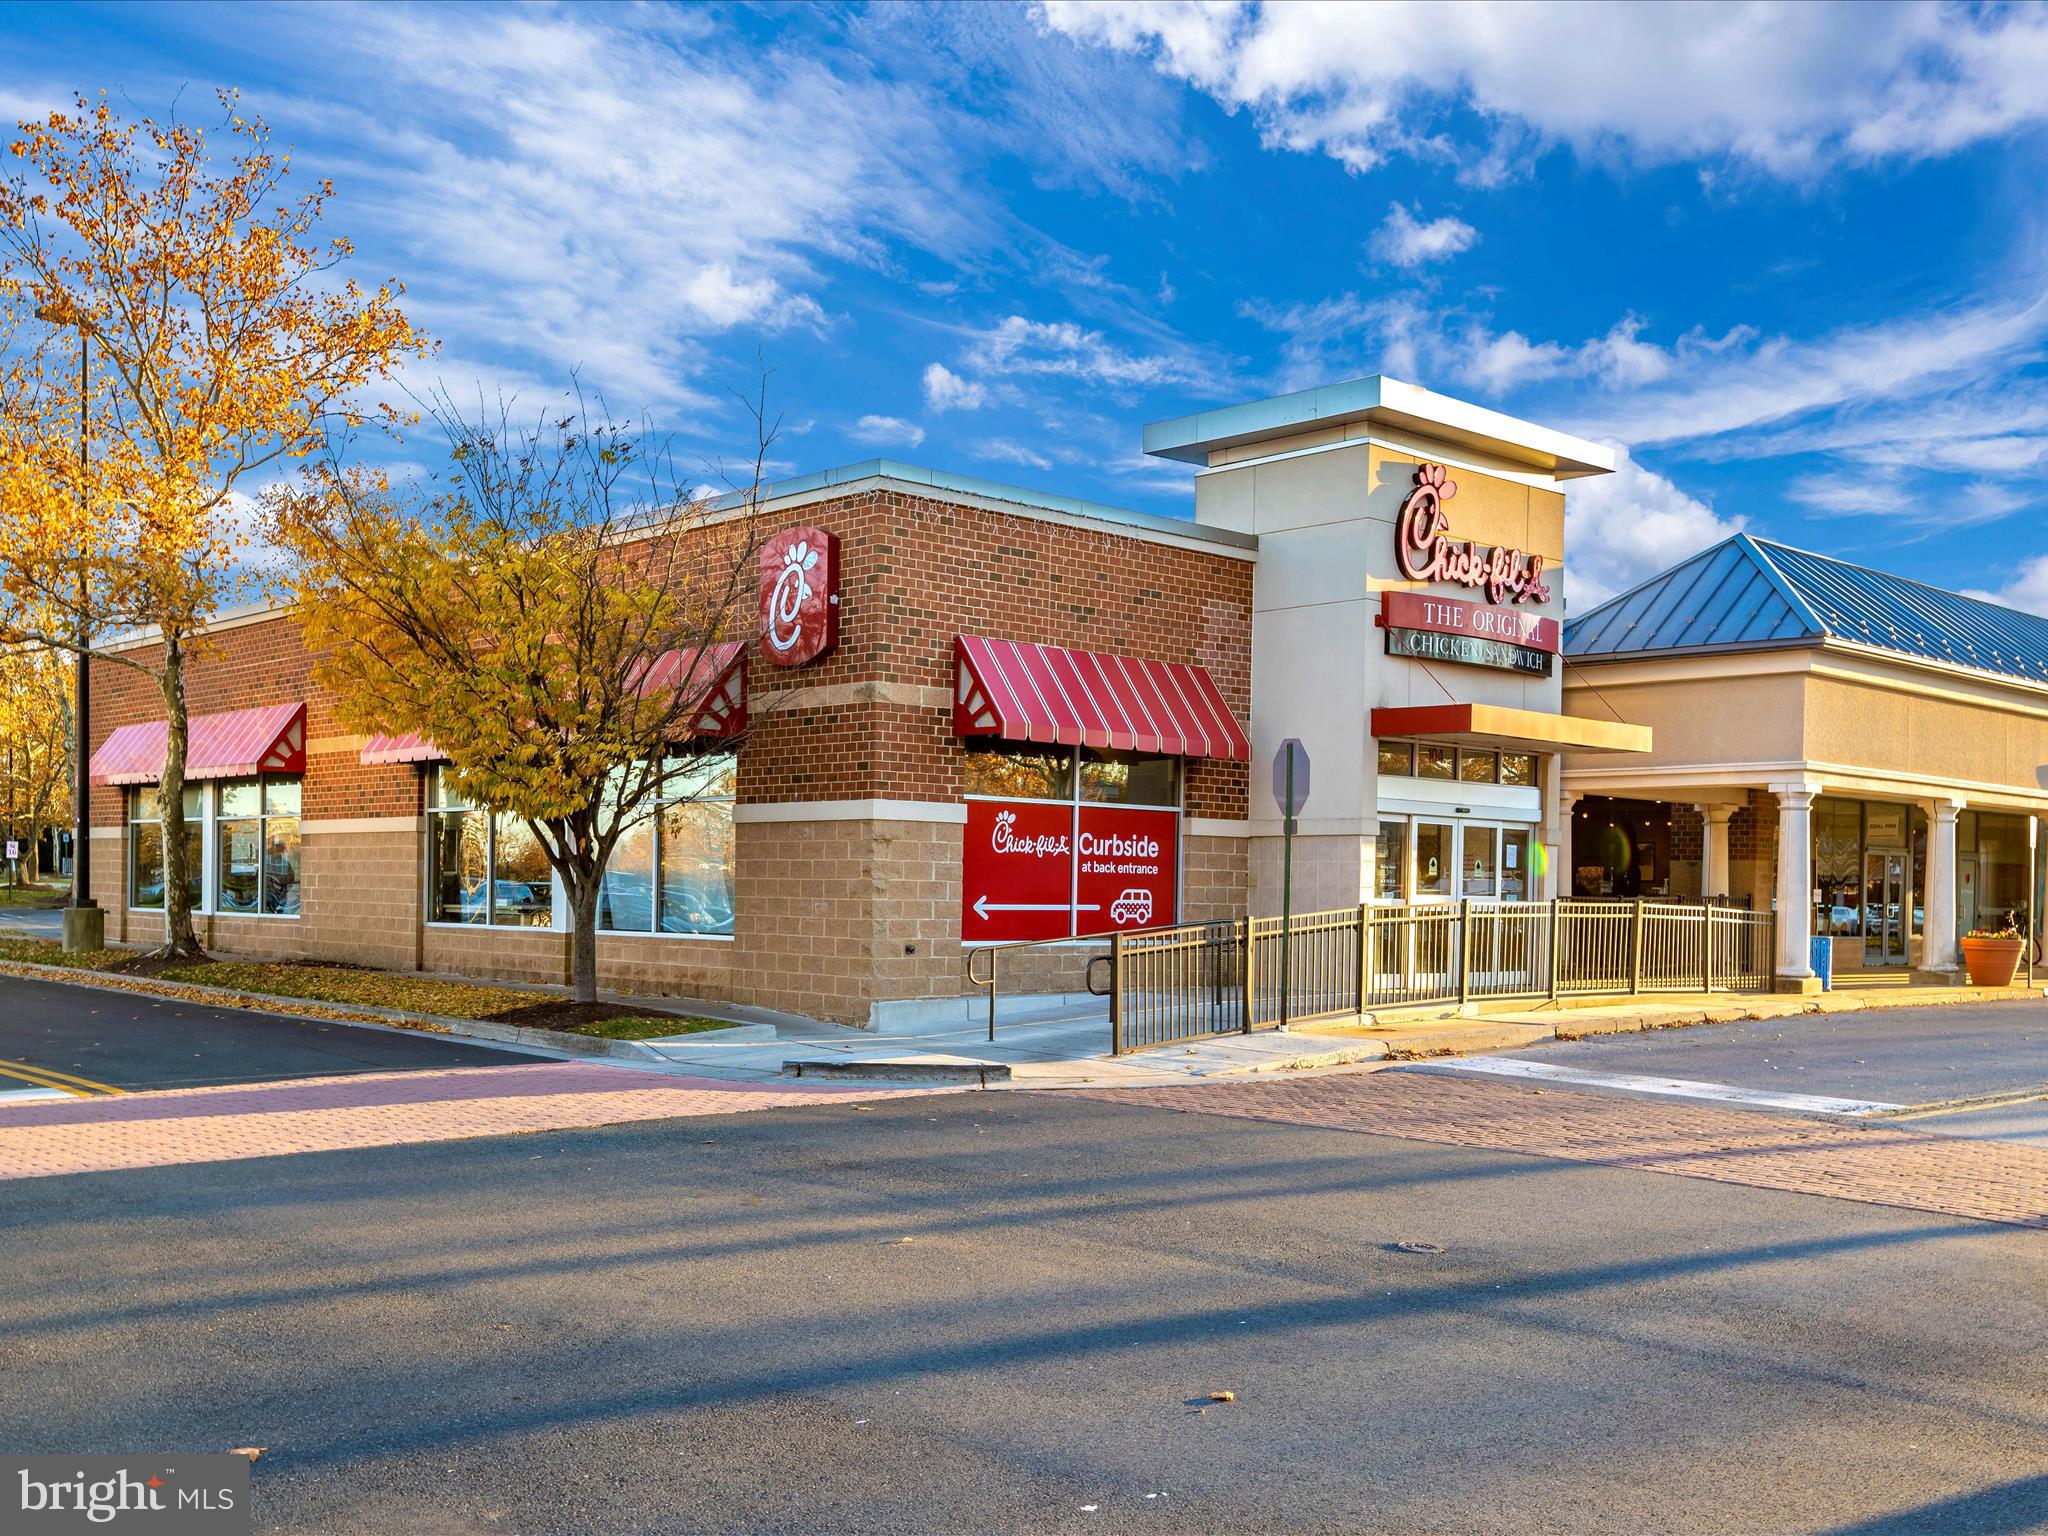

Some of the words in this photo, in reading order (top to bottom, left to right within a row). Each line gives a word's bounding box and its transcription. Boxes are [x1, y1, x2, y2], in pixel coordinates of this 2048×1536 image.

[1395, 480, 1550, 605] Chick-fil-A
[1423, 602, 1463, 628] THE
[1472, 610, 1543, 643] ORIGINAL
[1410, 634, 1478, 657] CHICKEN
[1485, 645, 1543, 670] SANDWICH
[992, 819, 1070, 858] Chick-fil-A
[1079, 832, 1159, 858] Curbside
[1081, 861, 1092, 873] at
[1093, 860, 1116, 873] back
[1117, 862, 1159, 875] entrance
